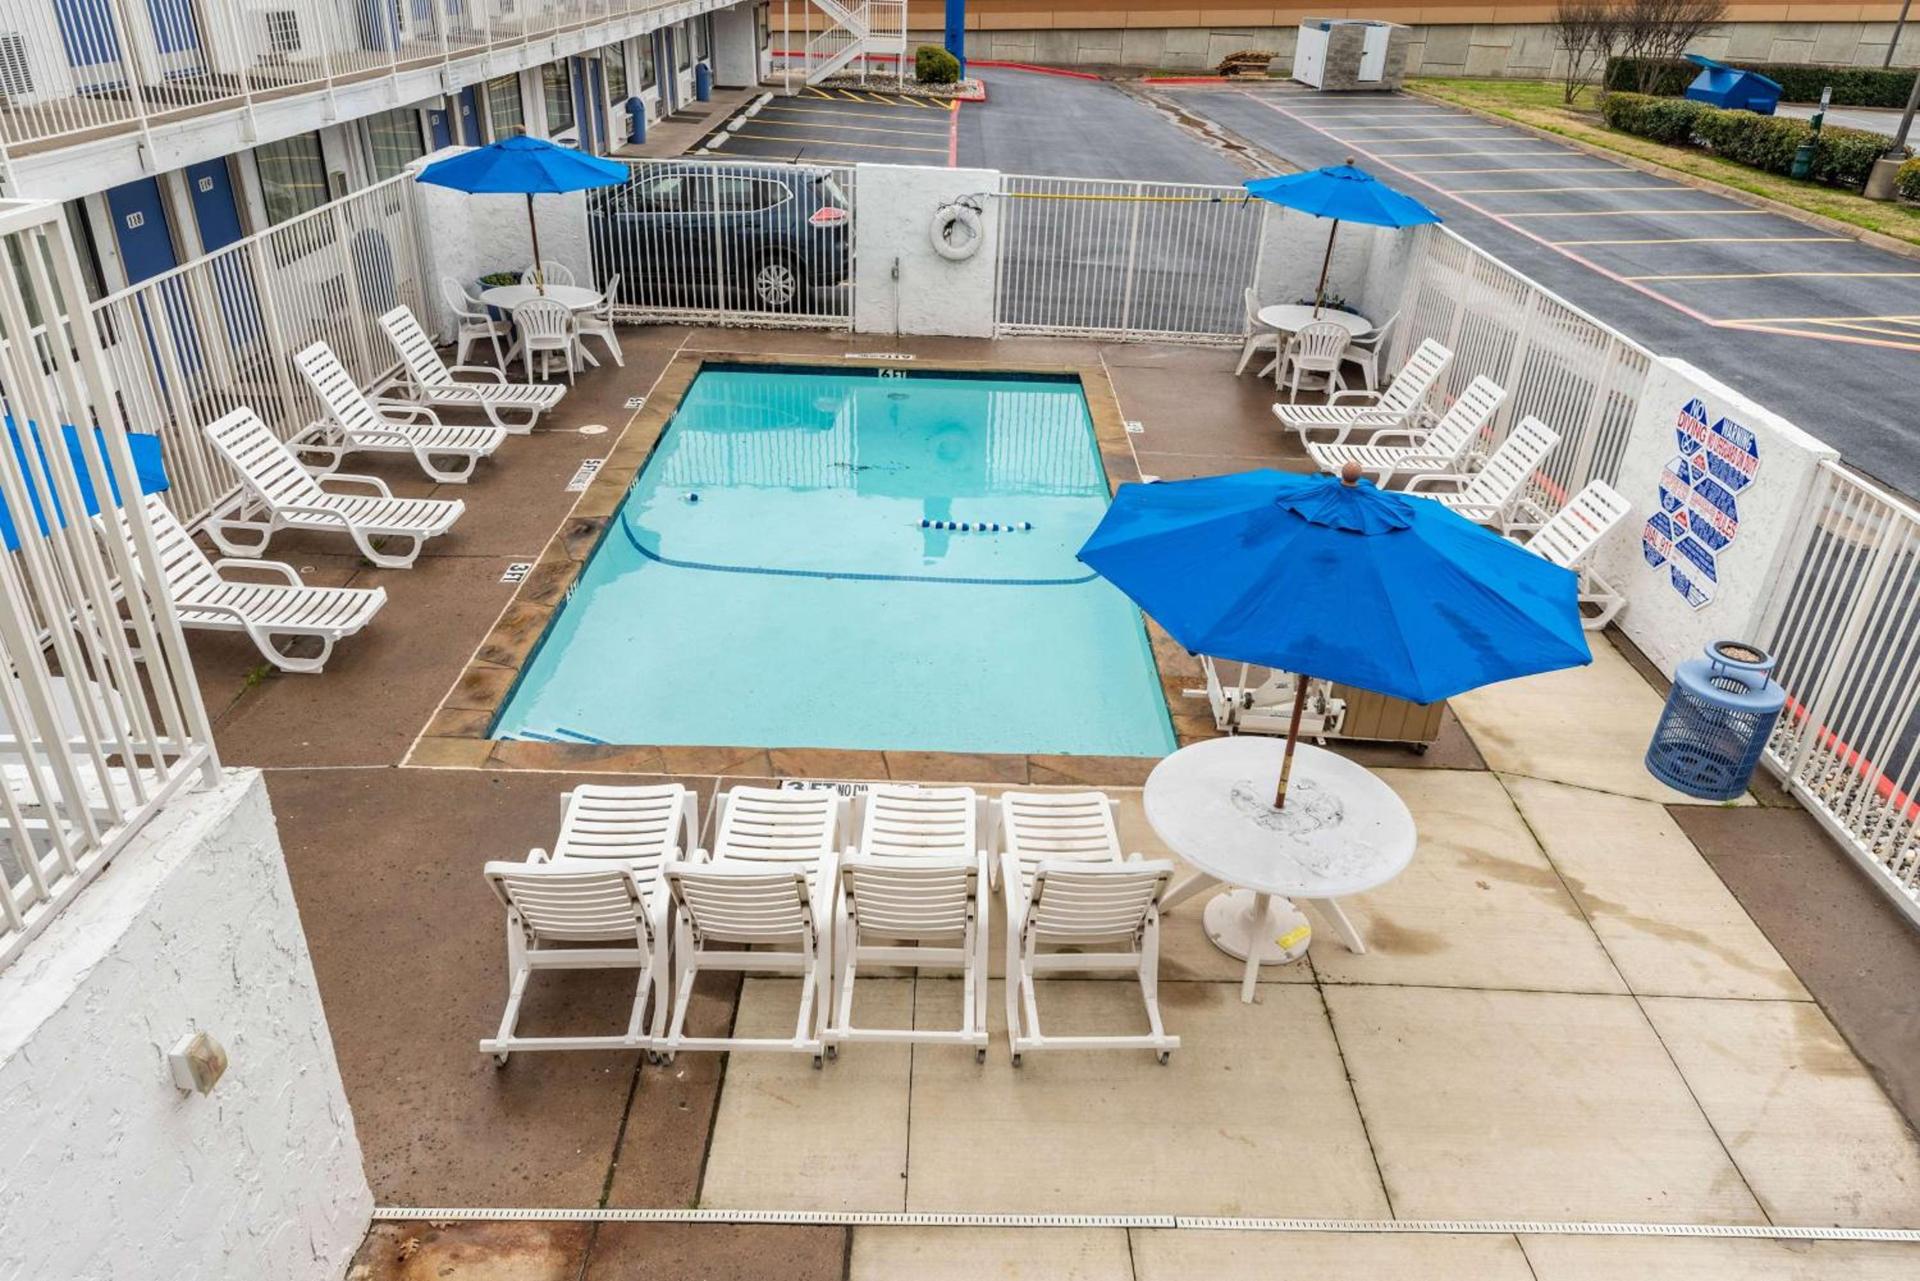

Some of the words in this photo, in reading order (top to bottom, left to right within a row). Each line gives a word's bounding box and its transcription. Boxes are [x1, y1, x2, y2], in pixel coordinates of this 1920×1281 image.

[1690, 399, 1705, 420] NO
[1677, 411, 1707, 442] DIVING
[1721, 418, 1752, 450] WARNING
[1713, 511, 1737, 539] RULES
[838, 784, 851, 796] NO
